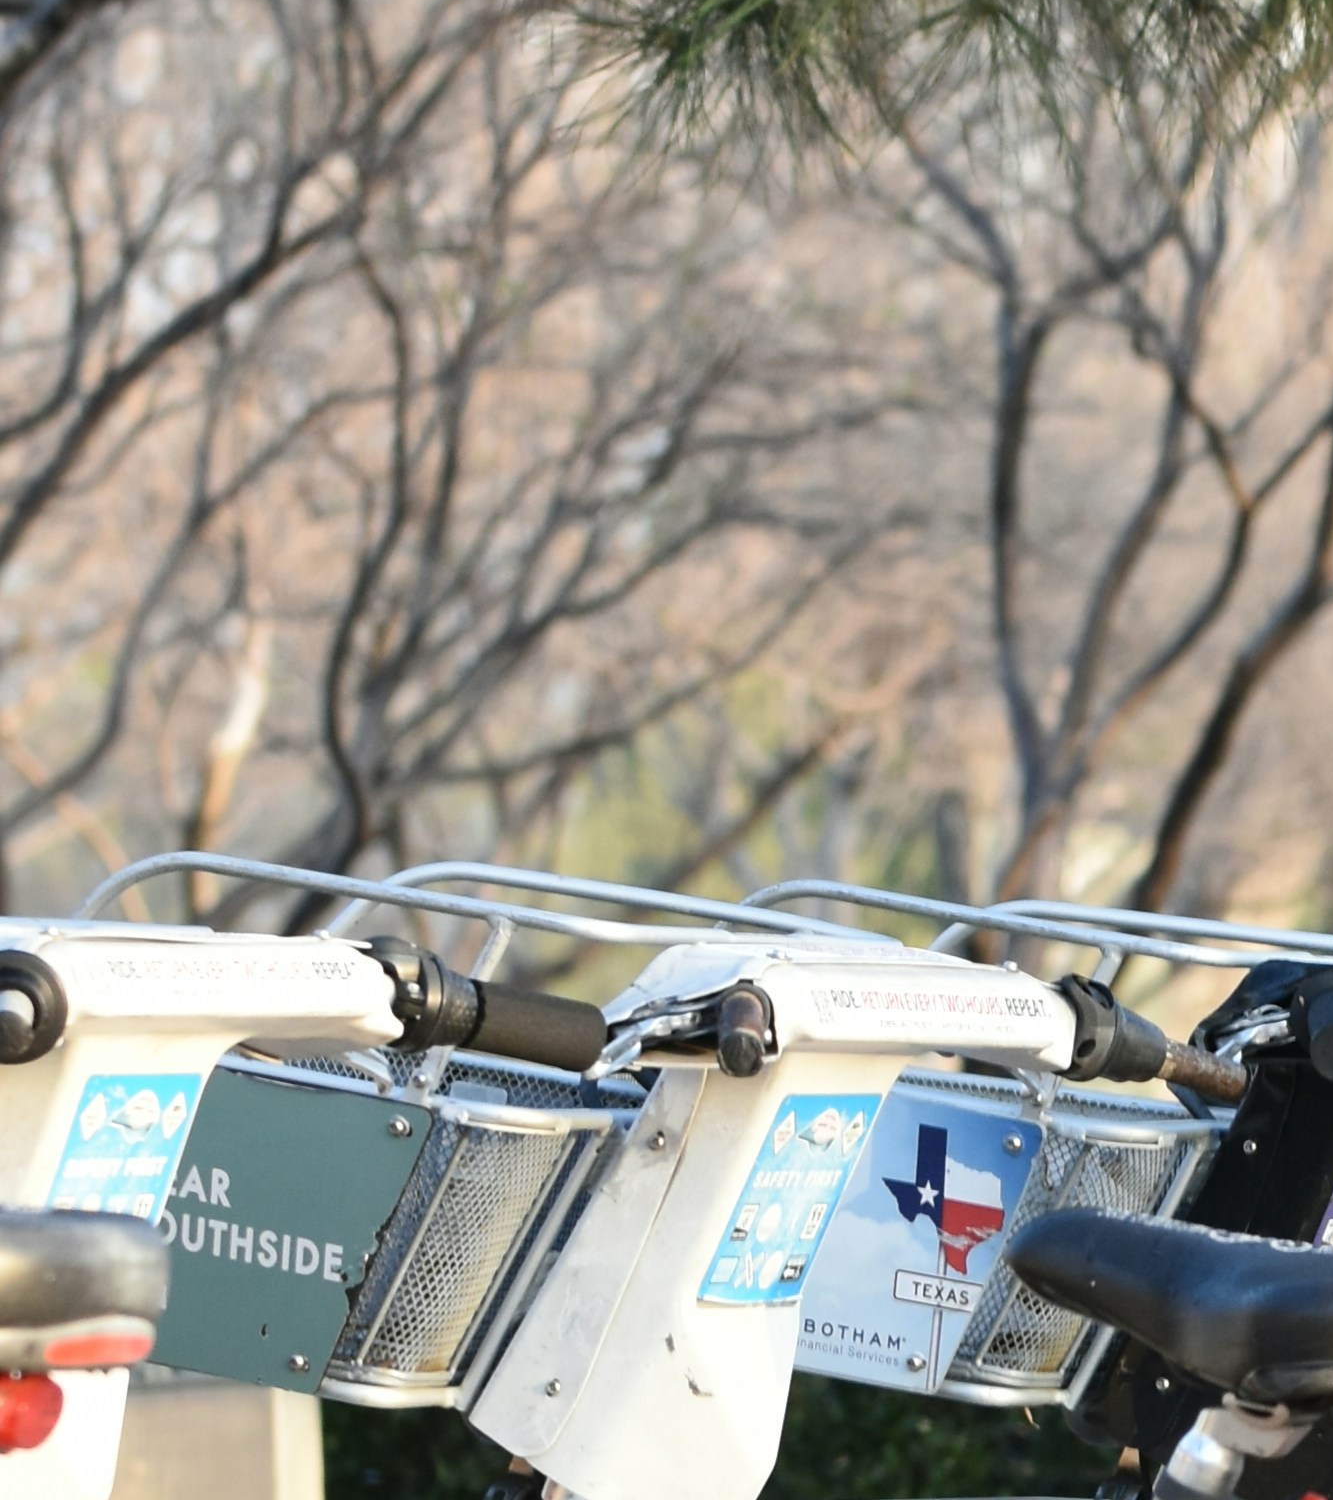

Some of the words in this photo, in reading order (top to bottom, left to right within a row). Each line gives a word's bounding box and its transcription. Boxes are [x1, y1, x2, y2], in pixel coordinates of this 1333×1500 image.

[170, 1164, 232, 1208] AR
[753, 1169, 803, 1189] SAFETY
[804, 1169, 843, 1188] FIRST
[160, 1208, 344, 1282] OUTHSIDE
[912, 1280, 970, 1306] TEXAS
[797, 1337, 843, 1357] inancial
[848, 1346, 900, 1367] Services
